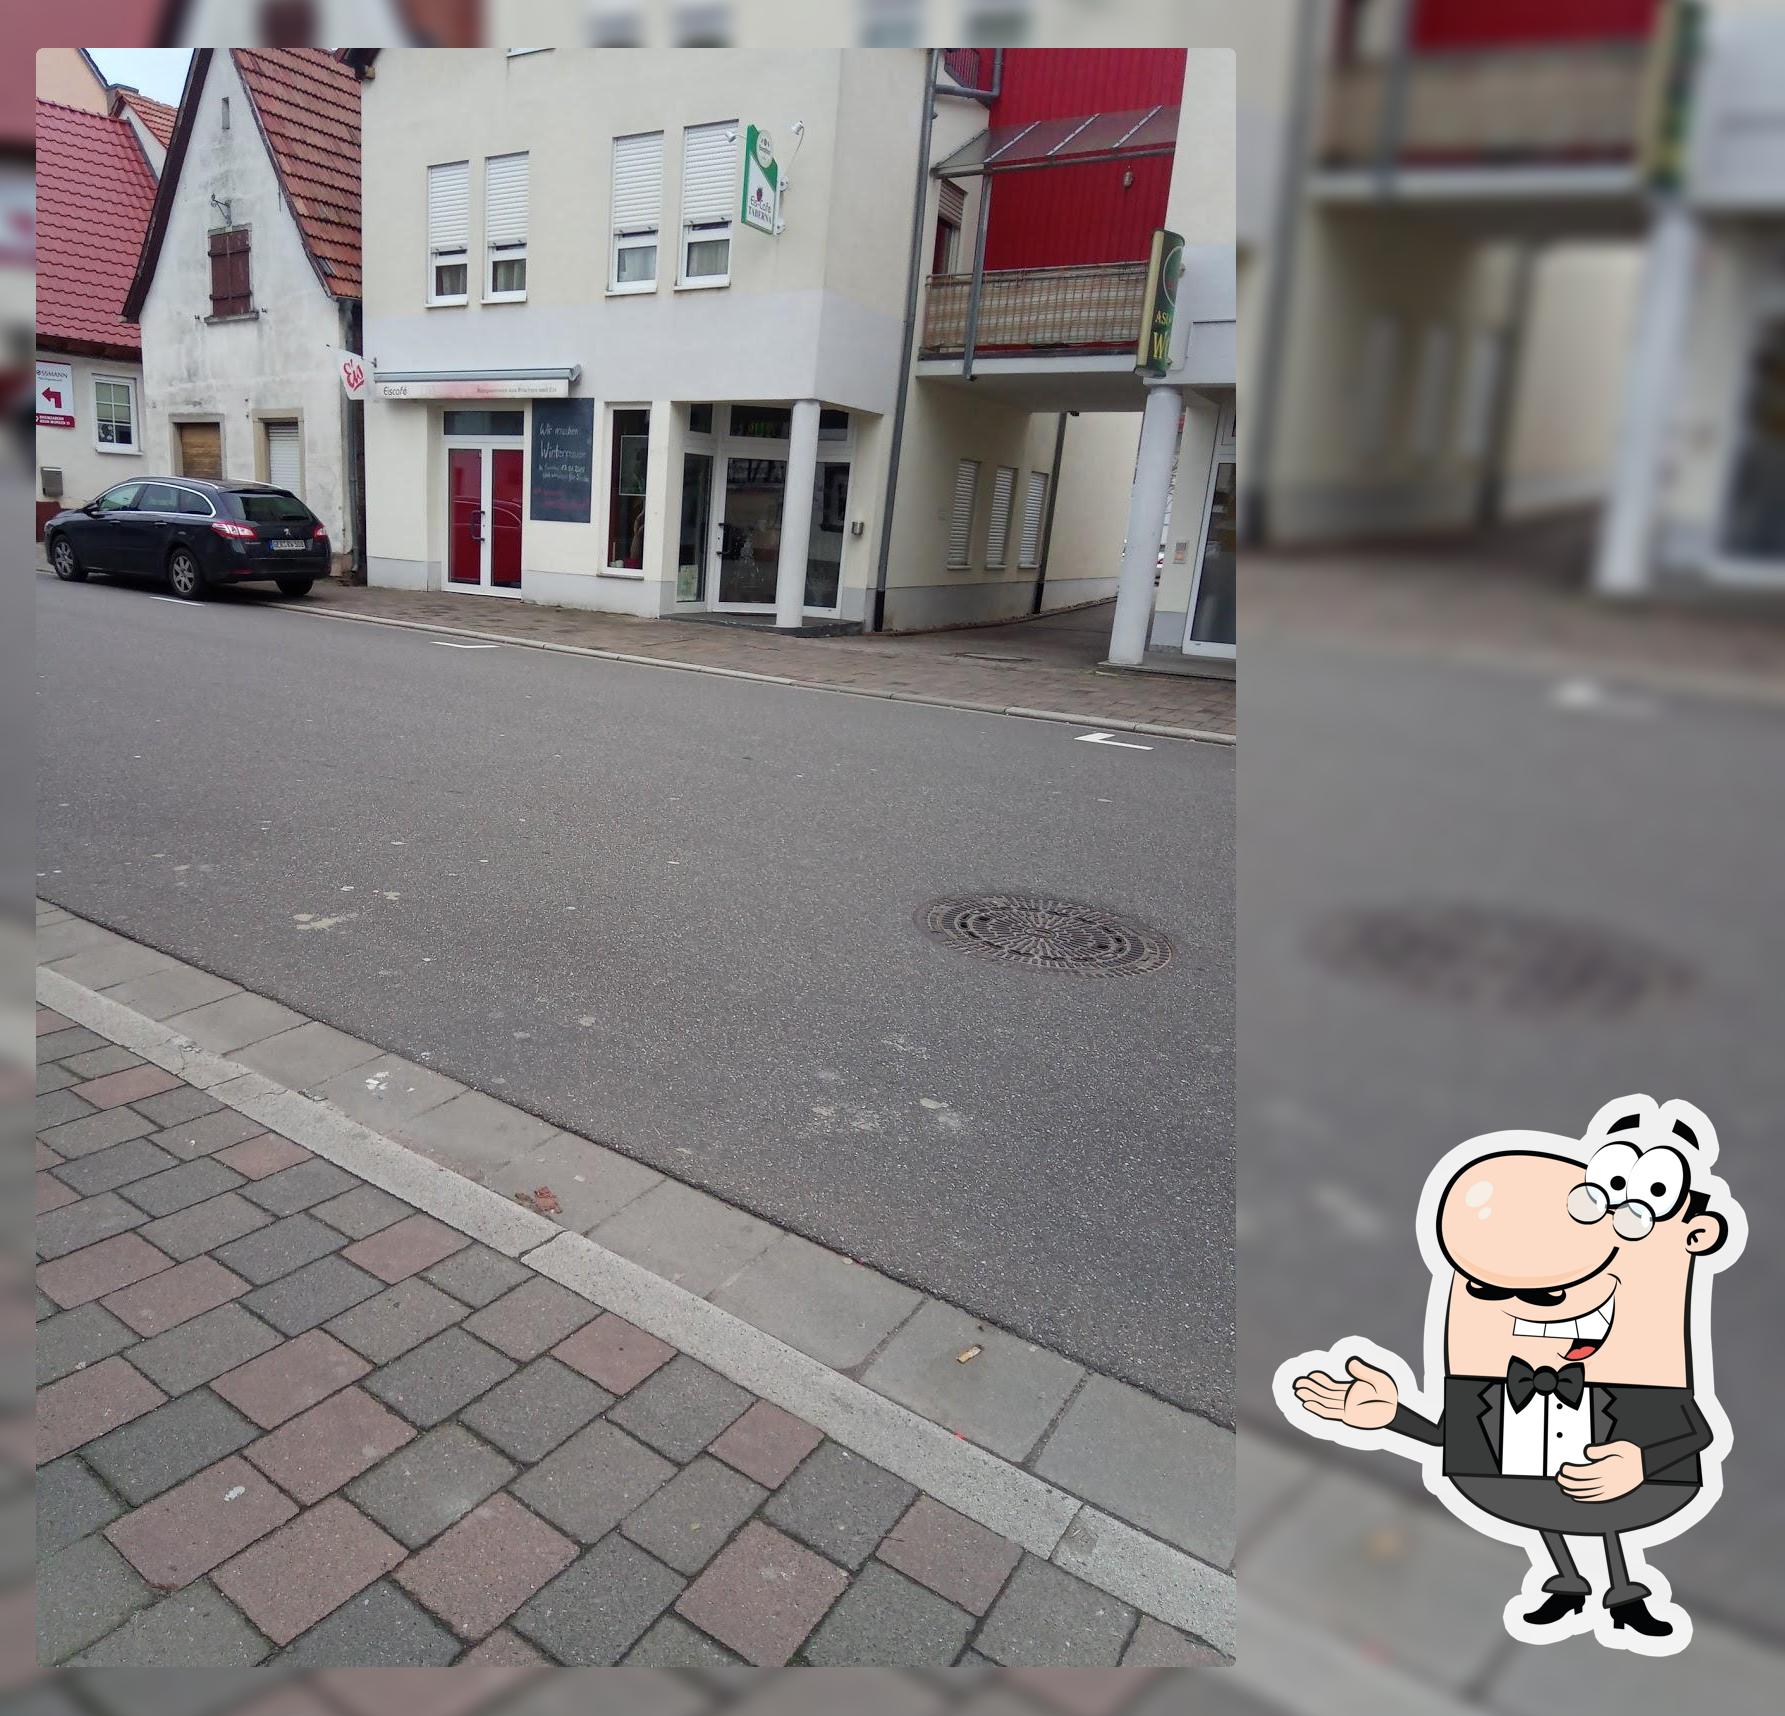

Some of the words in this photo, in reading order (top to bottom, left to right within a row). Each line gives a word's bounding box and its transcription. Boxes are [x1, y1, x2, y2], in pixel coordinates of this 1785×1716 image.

[37, 369, 68, 378] OSSMANN
[343, 359, 364, 391] Eis
[384, 386, 407, 396] Eiscafé
